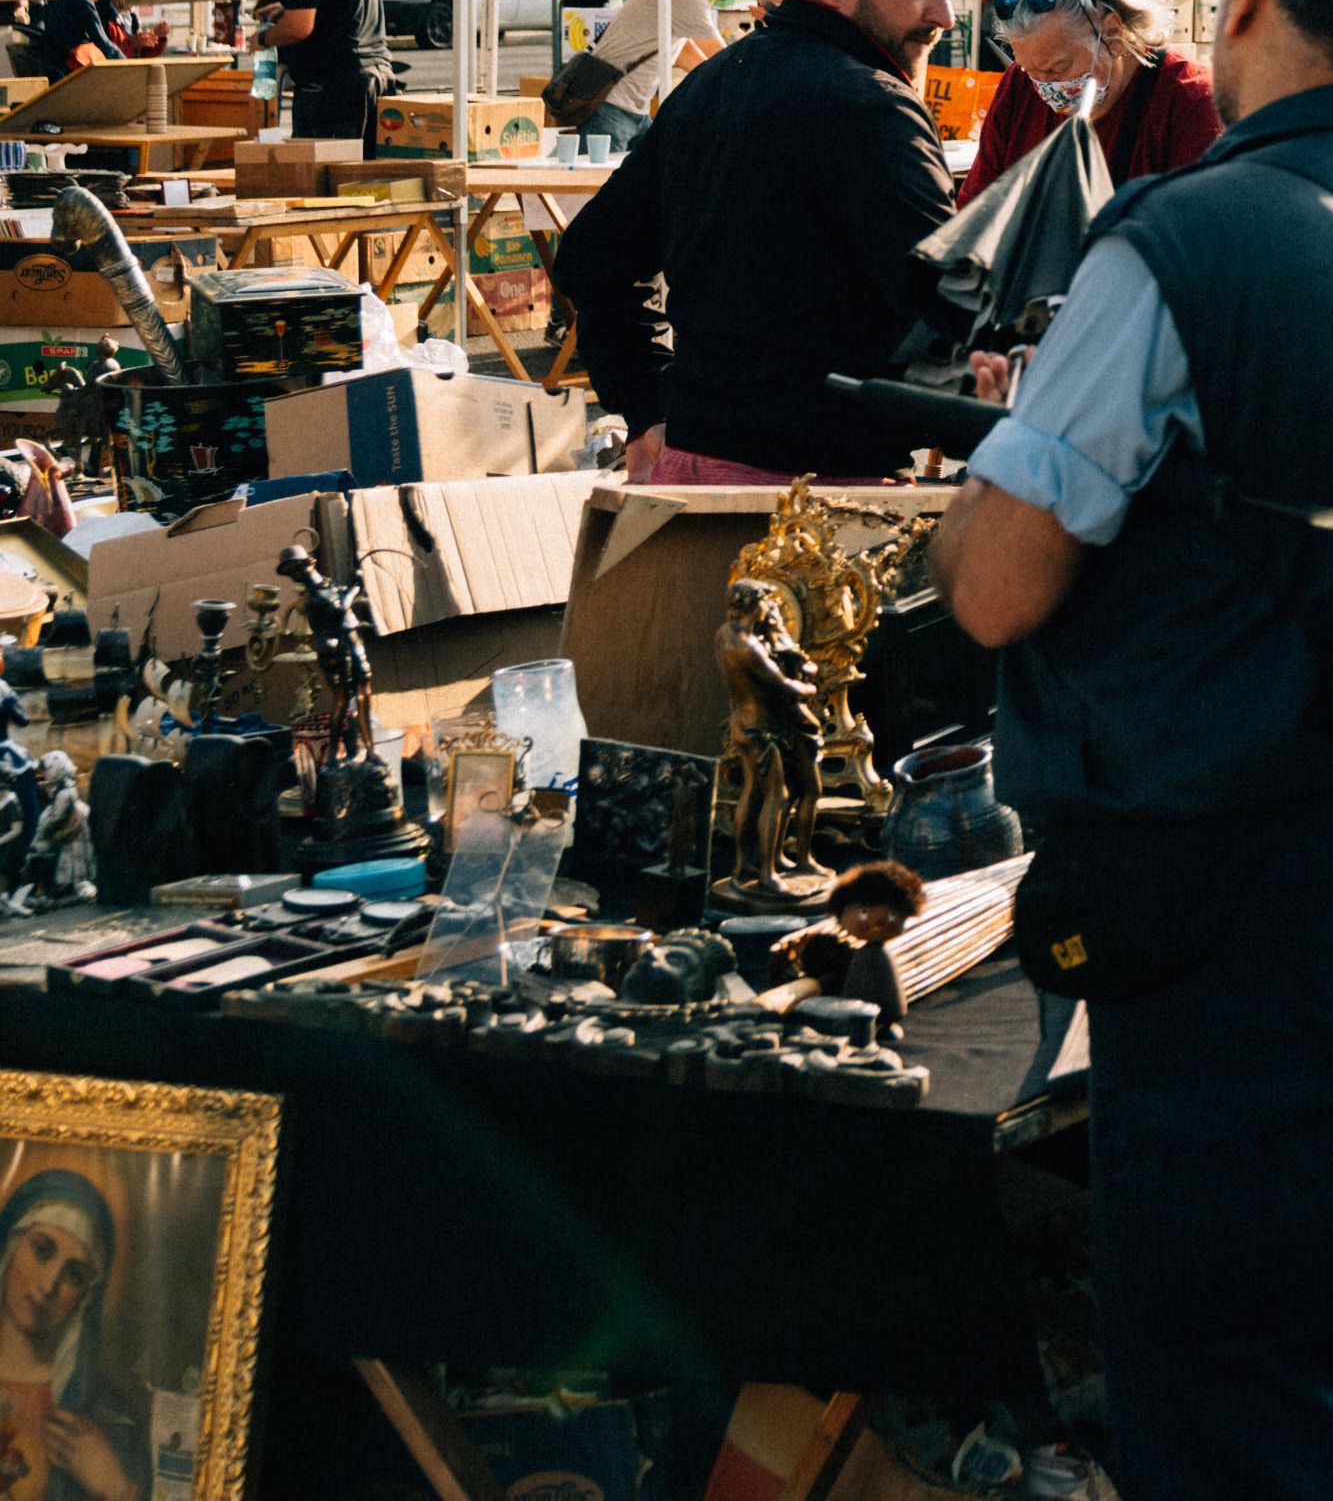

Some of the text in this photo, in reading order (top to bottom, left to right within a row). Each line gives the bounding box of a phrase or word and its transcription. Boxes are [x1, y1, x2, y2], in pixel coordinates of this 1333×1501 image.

[500, 280, 526, 299] One
[385, 386, 402, 473] Taste the SUN
